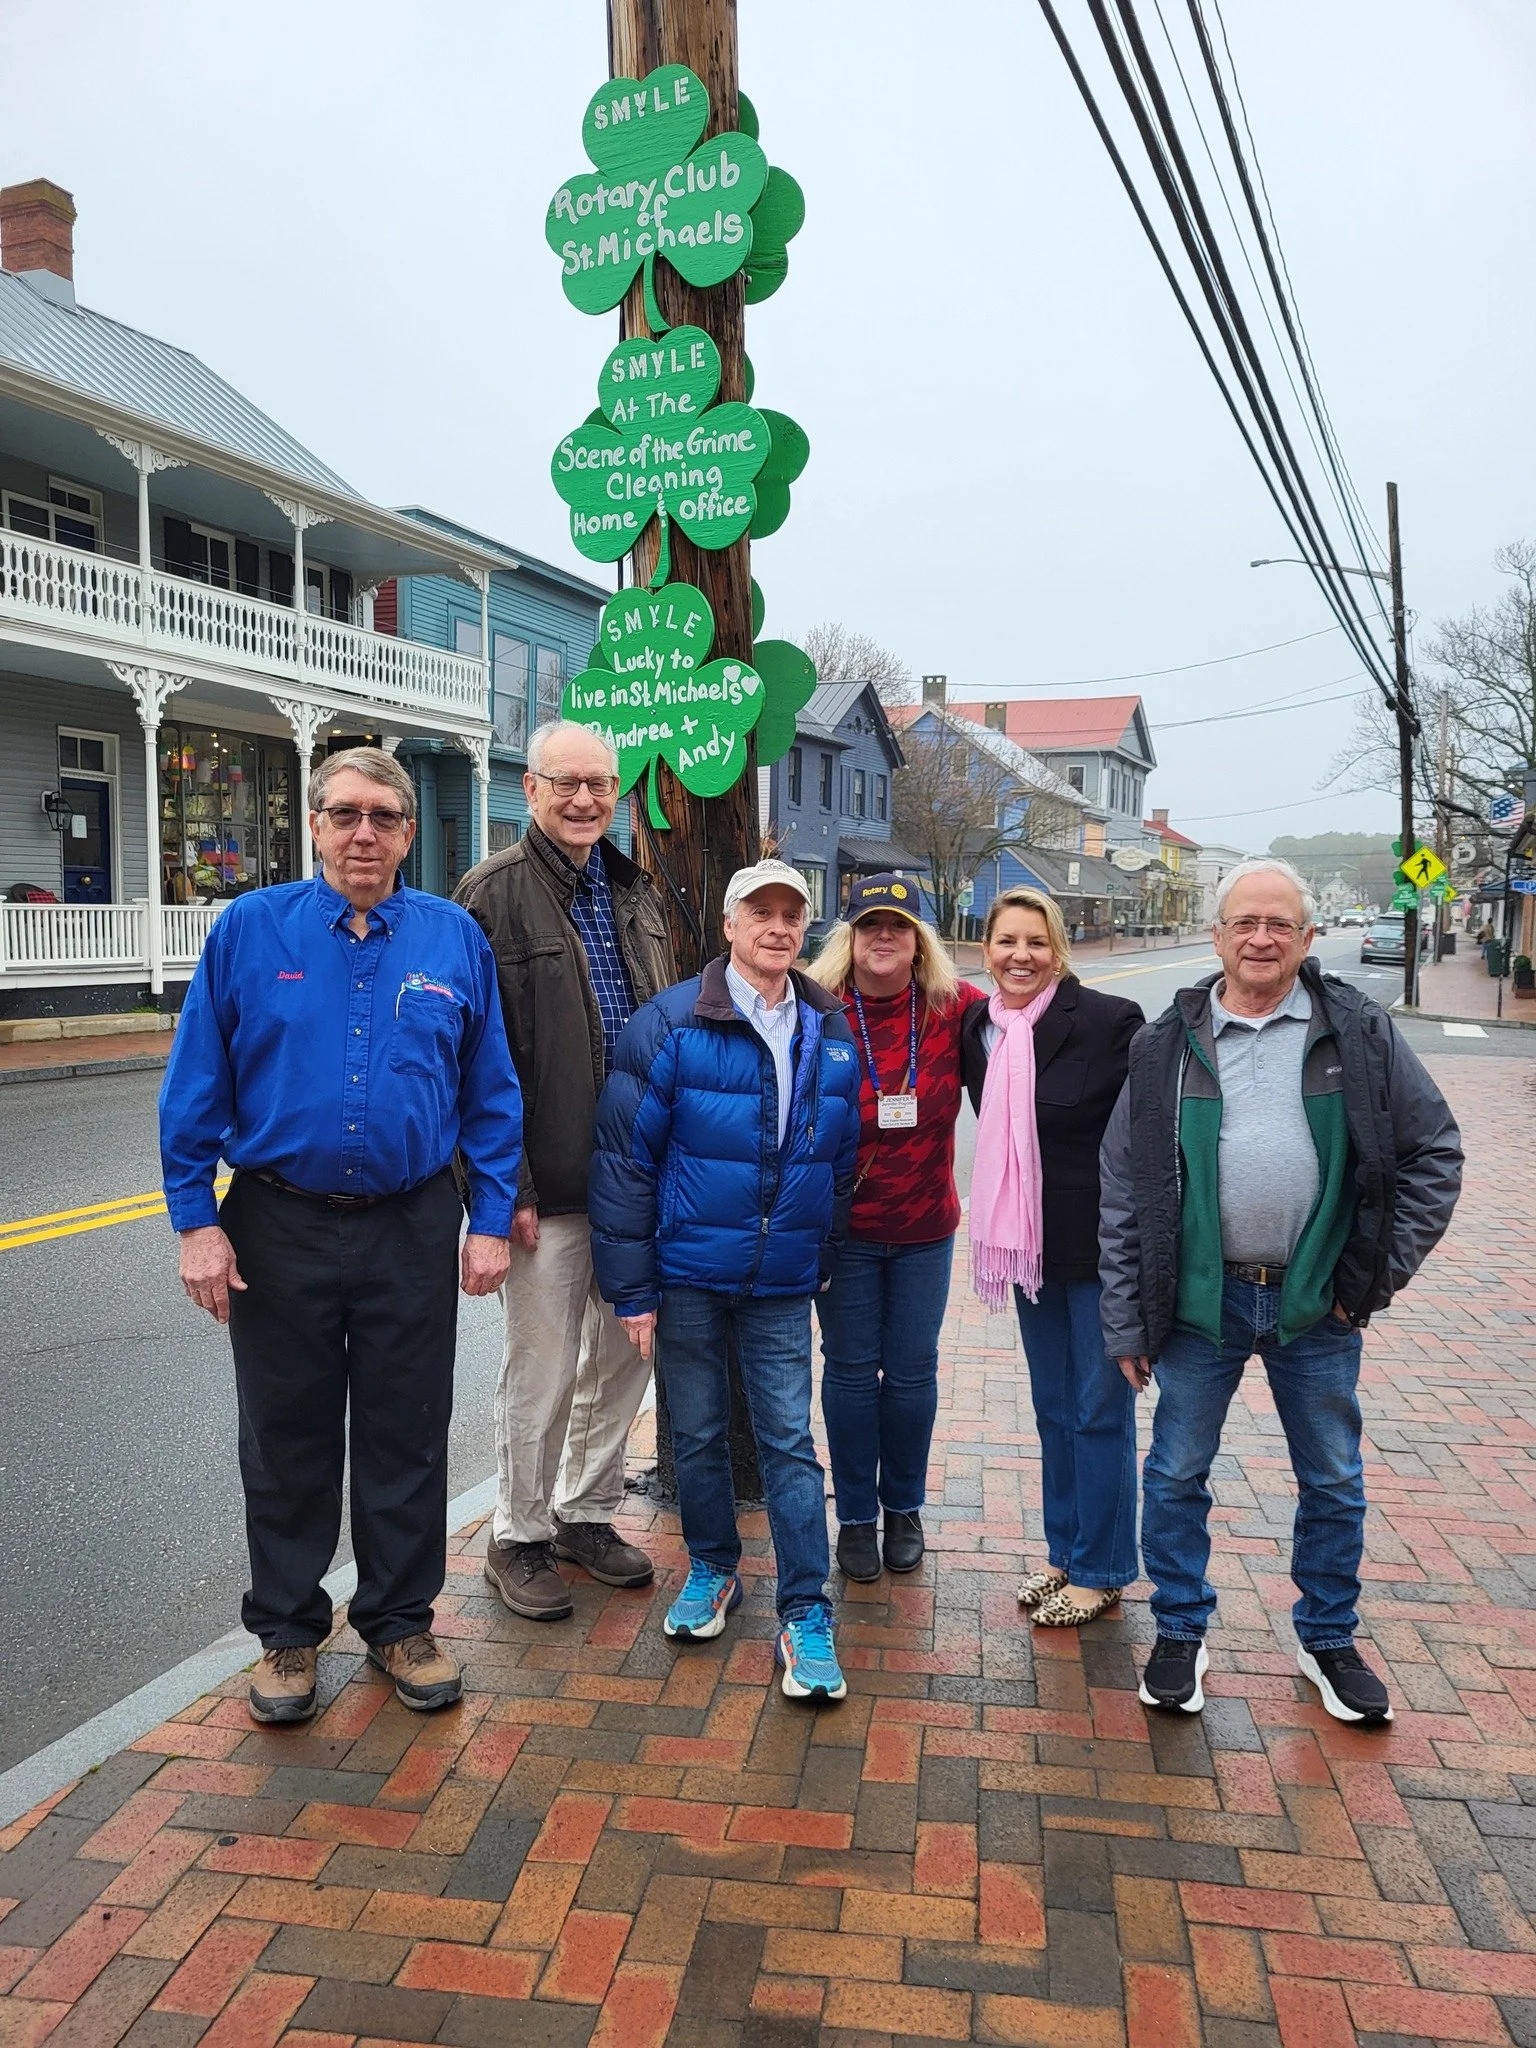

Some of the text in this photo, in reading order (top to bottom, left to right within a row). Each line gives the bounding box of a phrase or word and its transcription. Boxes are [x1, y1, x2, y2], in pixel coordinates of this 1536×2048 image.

[594, 76, 691, 130] SMYLE
[554, 150, 740, 225] Rotary Club
[636, 193, 668, 228] of
[611, 342, 706, 383] SMYLE
[610, 391, 696, 424] At The
[557, 426, 756, 472] Scene of the Grime
[606, 462, 723, 500] Cleaning
[573, 511, 638, 537] Home
[606, 604, 702, 642] SMYLE
[614, 645, 694, 679] Lucky to
[571, 683, 606, 709] live
[604, 722, 673, 750] Andrea
[678, 723, 735, 774] Andy
[862, 886, 888, 897] Rotary
[277, 970, 305, 980] David
[855, 1000, 874, 1067] INTERNATIONAL
